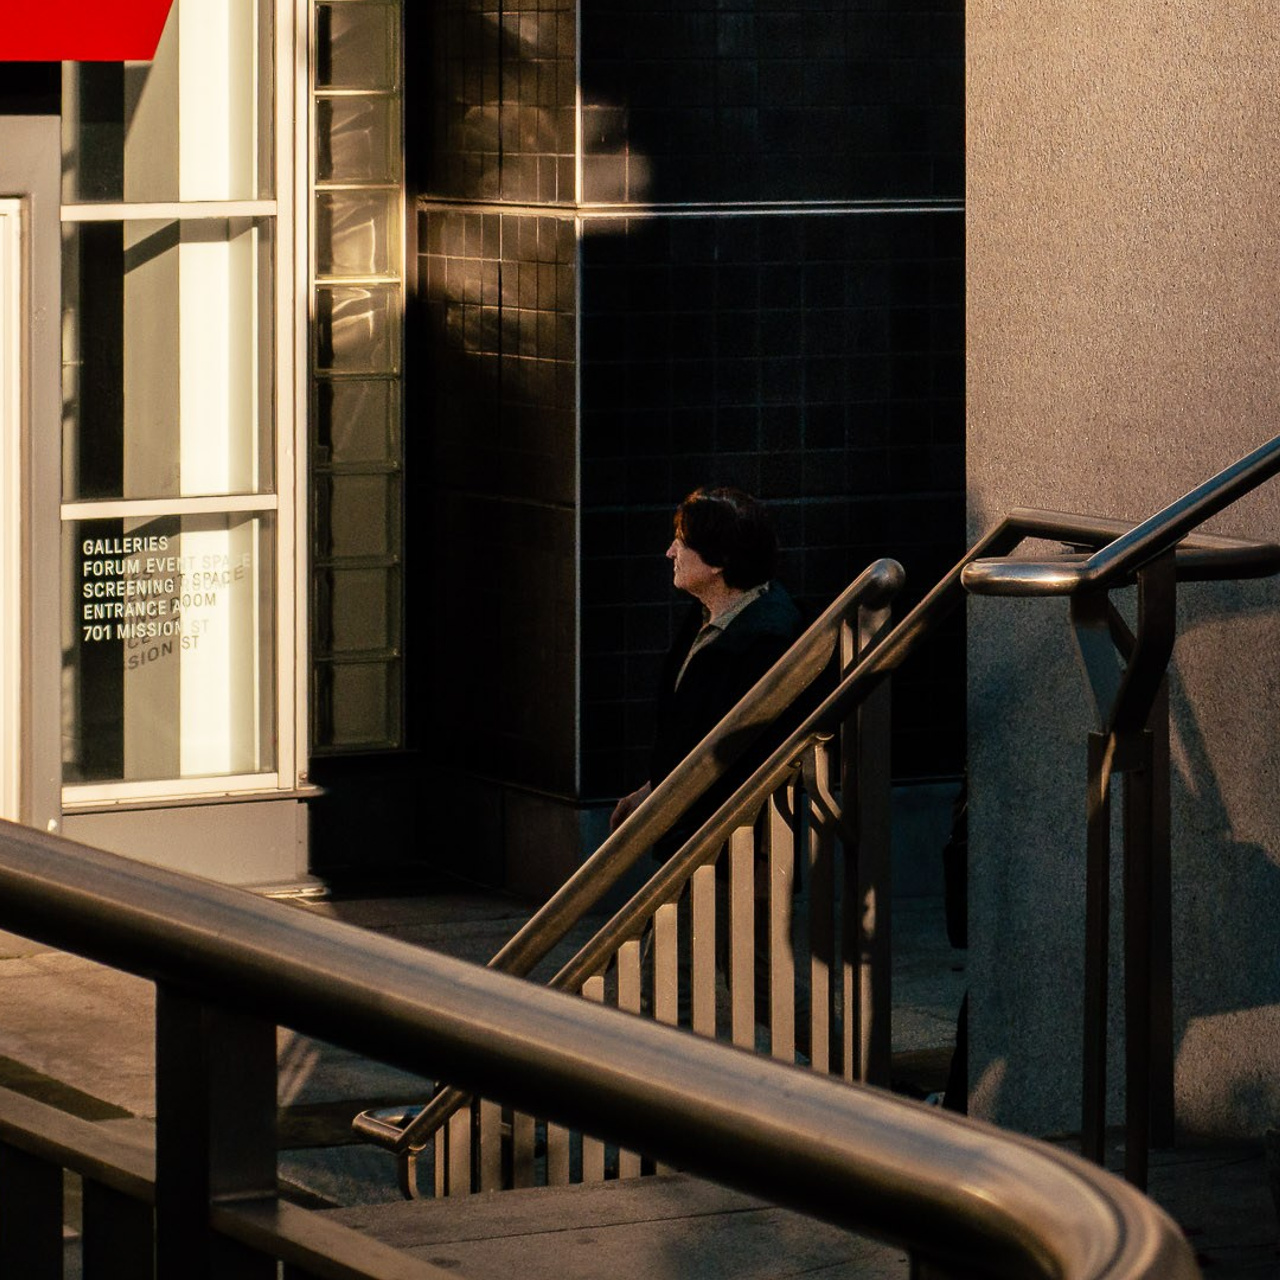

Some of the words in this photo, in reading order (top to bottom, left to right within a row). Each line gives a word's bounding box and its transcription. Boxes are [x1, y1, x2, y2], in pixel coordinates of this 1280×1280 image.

[82, 537, 169, 555] GALLERIES
[83, 559, 140, 577] FORUM
[202, 553, 251, 569] SPAE
[82, 579, 174, 598] SCREENING
[83, 601, 167, 620] ENTRANCE
[82, 624, 112, 642] 701
[117, 620, 185, 639] MISSION
